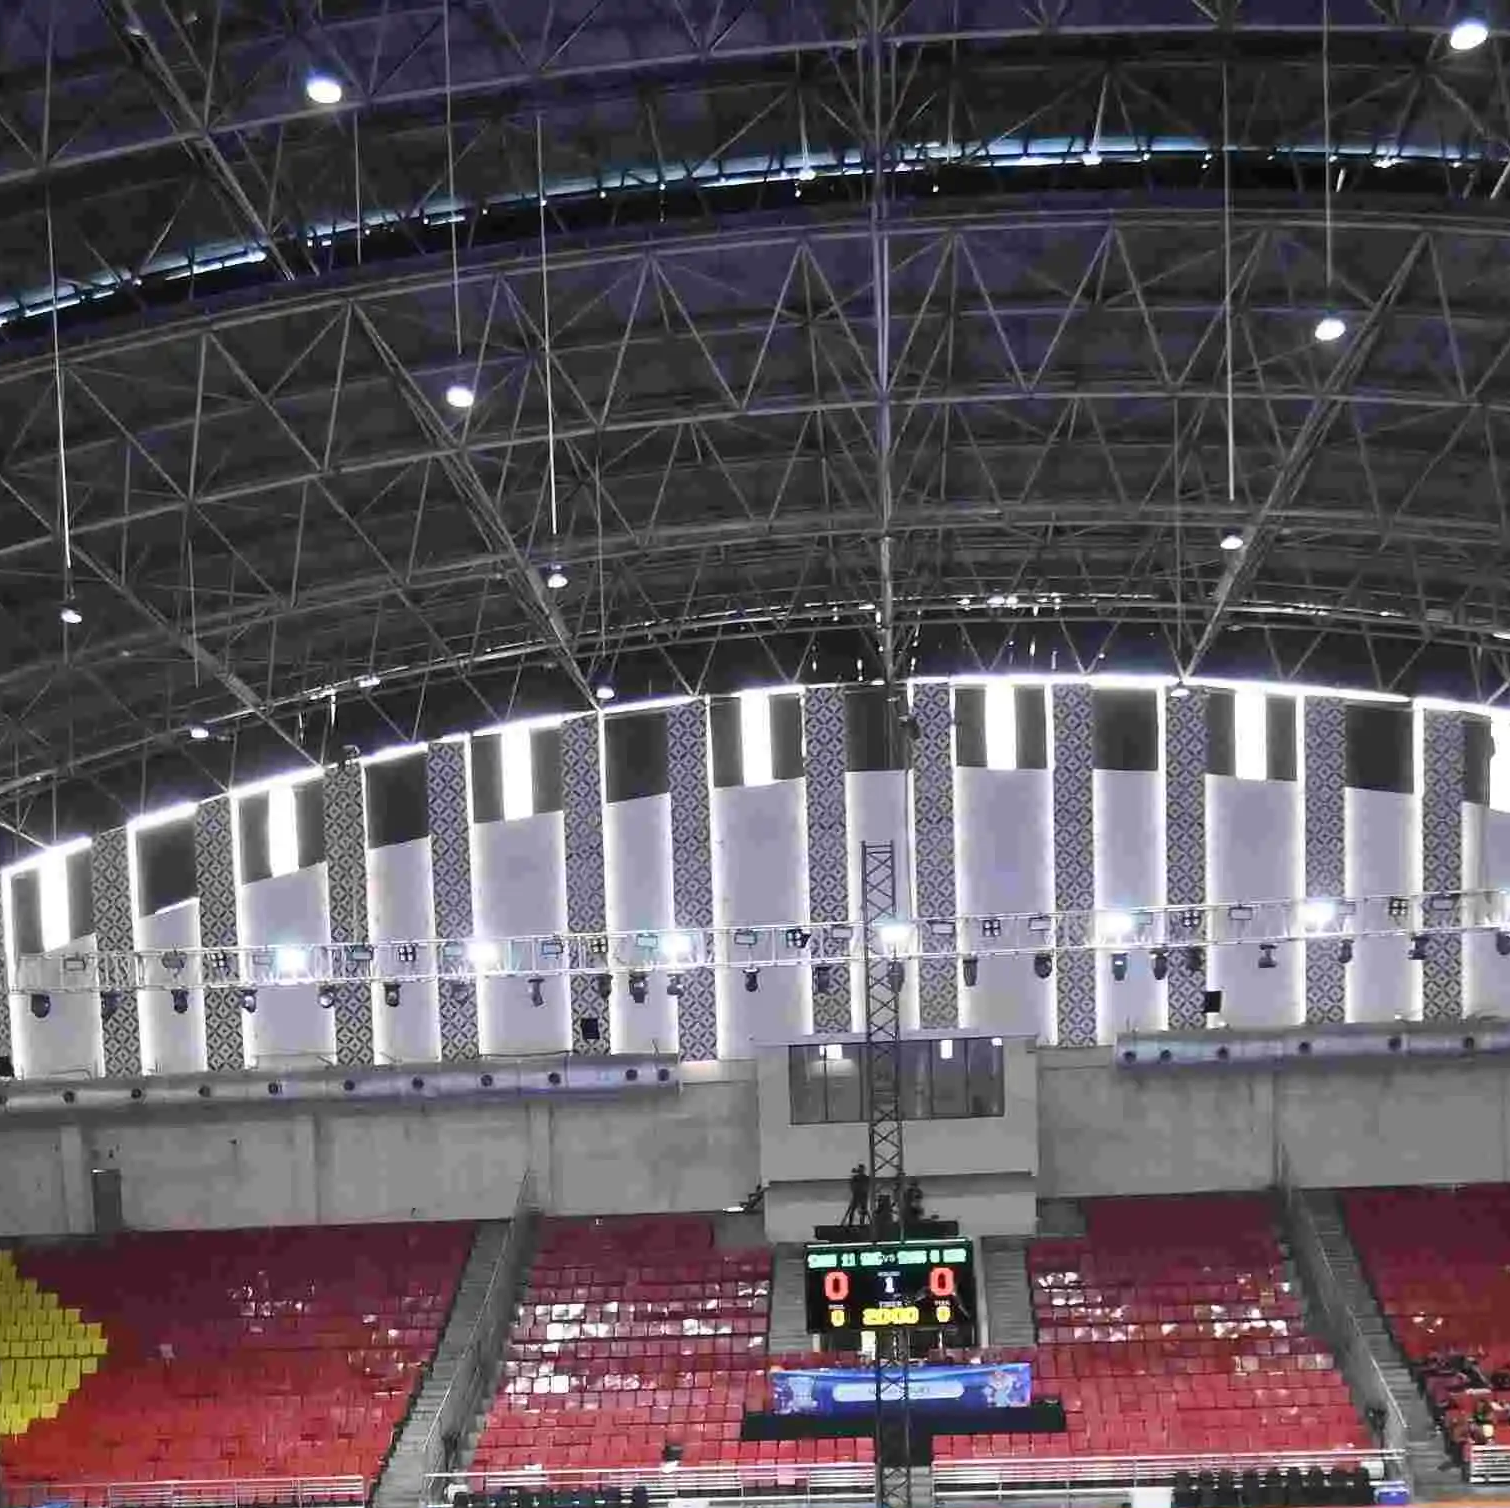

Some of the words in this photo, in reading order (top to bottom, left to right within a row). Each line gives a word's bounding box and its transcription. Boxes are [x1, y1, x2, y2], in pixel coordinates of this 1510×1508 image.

[825, 1271, 849, 1300] 0
[930, 1267, 954, 1296] 0
[884, 1276, 895, 1293] 1
